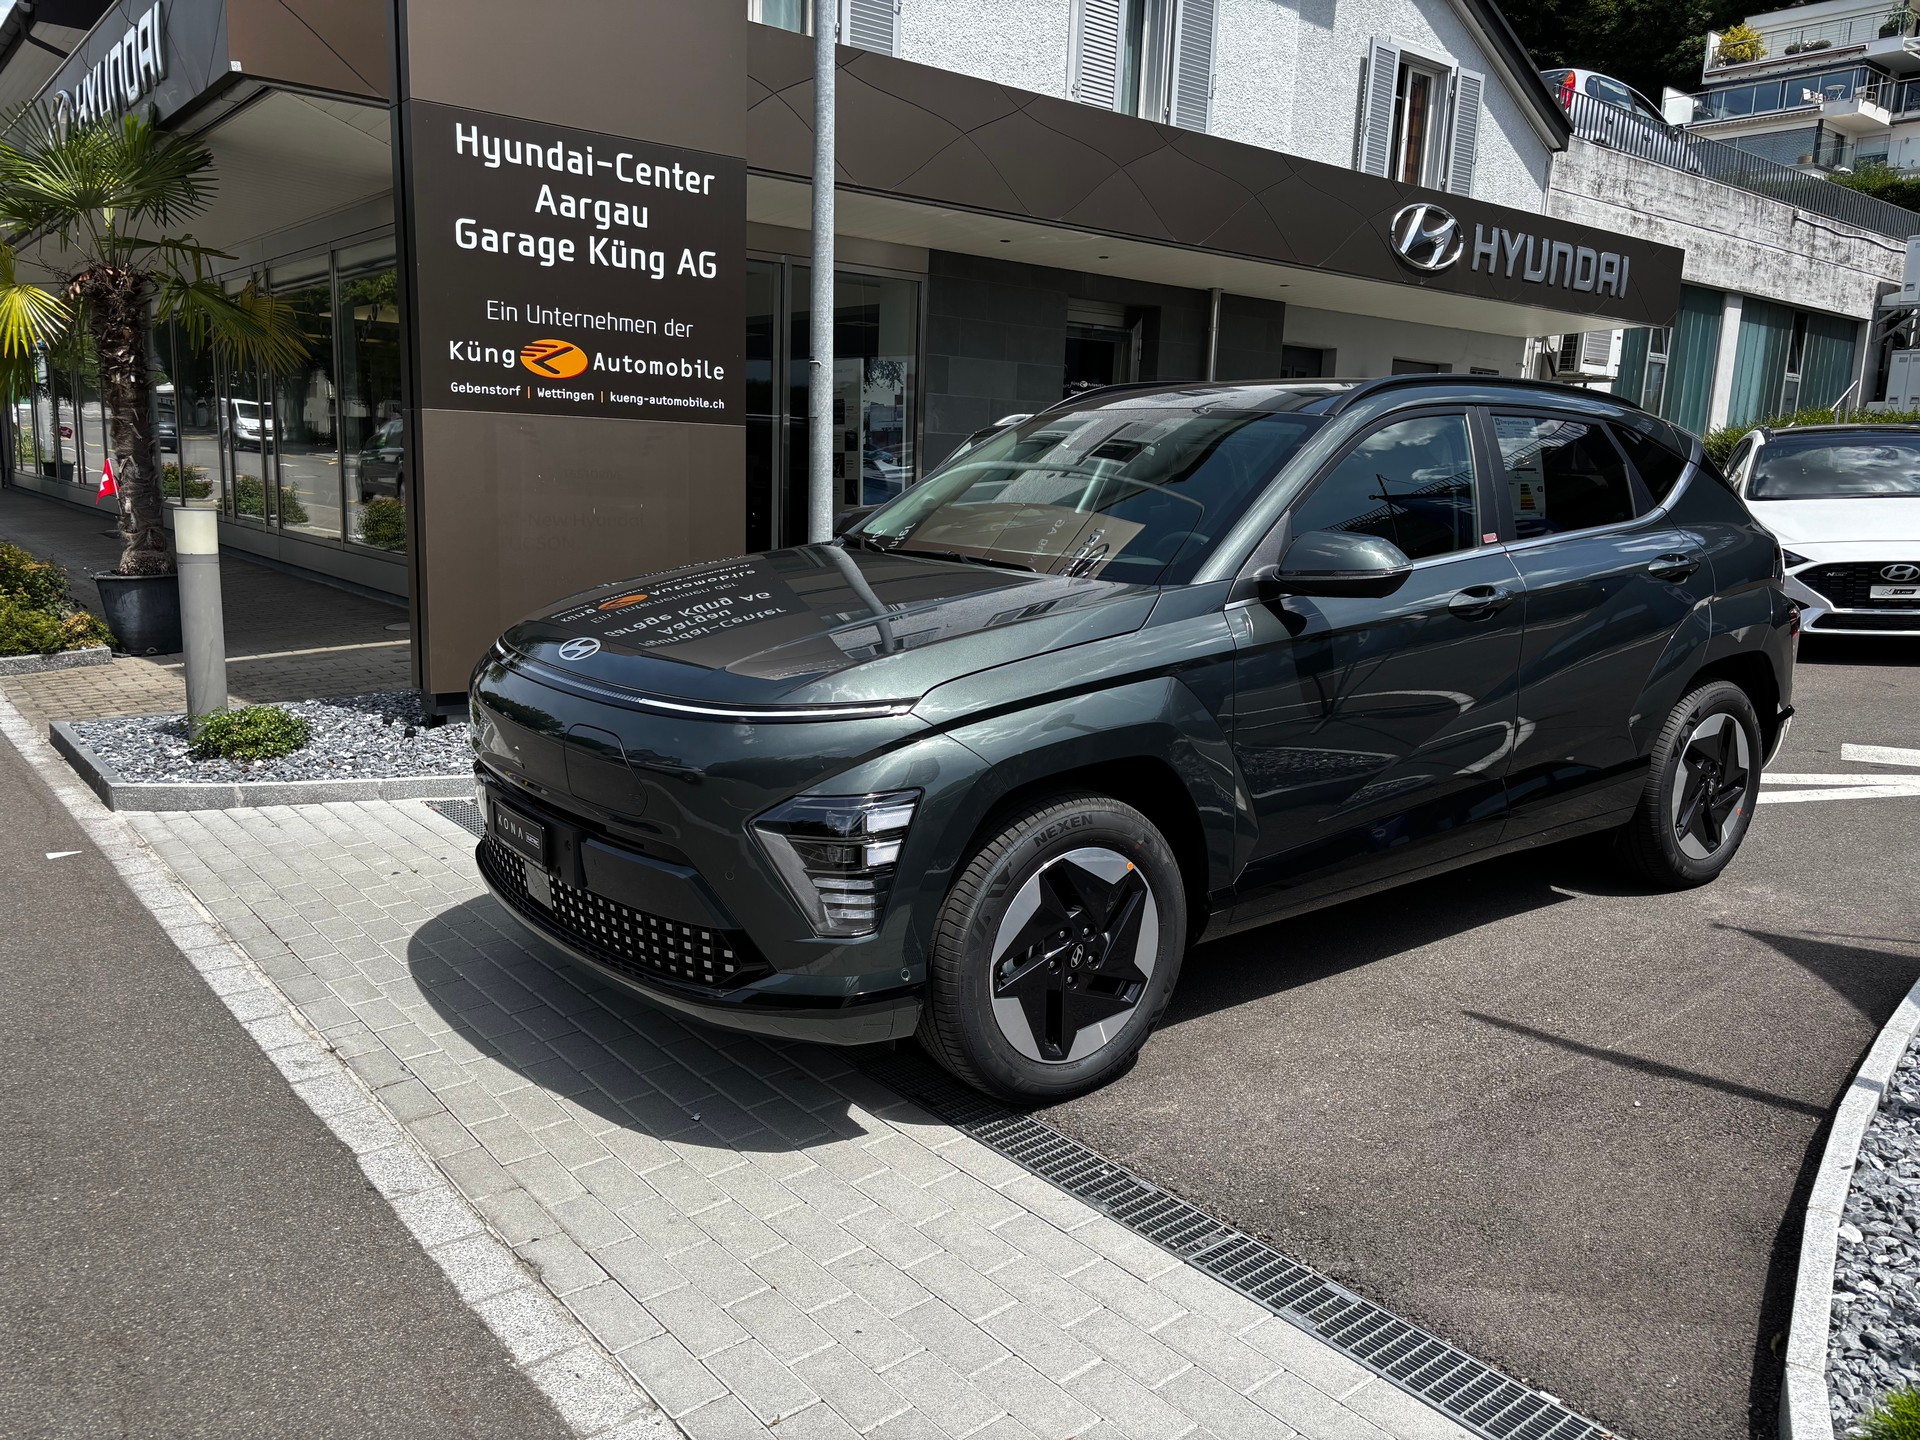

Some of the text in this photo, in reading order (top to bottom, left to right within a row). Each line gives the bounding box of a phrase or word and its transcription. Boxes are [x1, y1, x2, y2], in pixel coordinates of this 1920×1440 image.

[75, 0, 168, 130] HYUNDAI
[455, 122, 716, 196] Hyundai-Center
[535, 184, 649, 230] Aargau
[455, 217, 717, 280] Garage Küng AG
[1471, 223, 1631, 299] HYUNDAI
[487, 300, 694, 338] Ein Unternehmen der
[449, 340, 725, 380] Küng Automobile
[450, 382, 725, 410] Gebenstorf Wettingen kueng-automobile.ch
[497, 813, 524, 840] KONA
[1033, 814, 1094, 848] NEXEN
